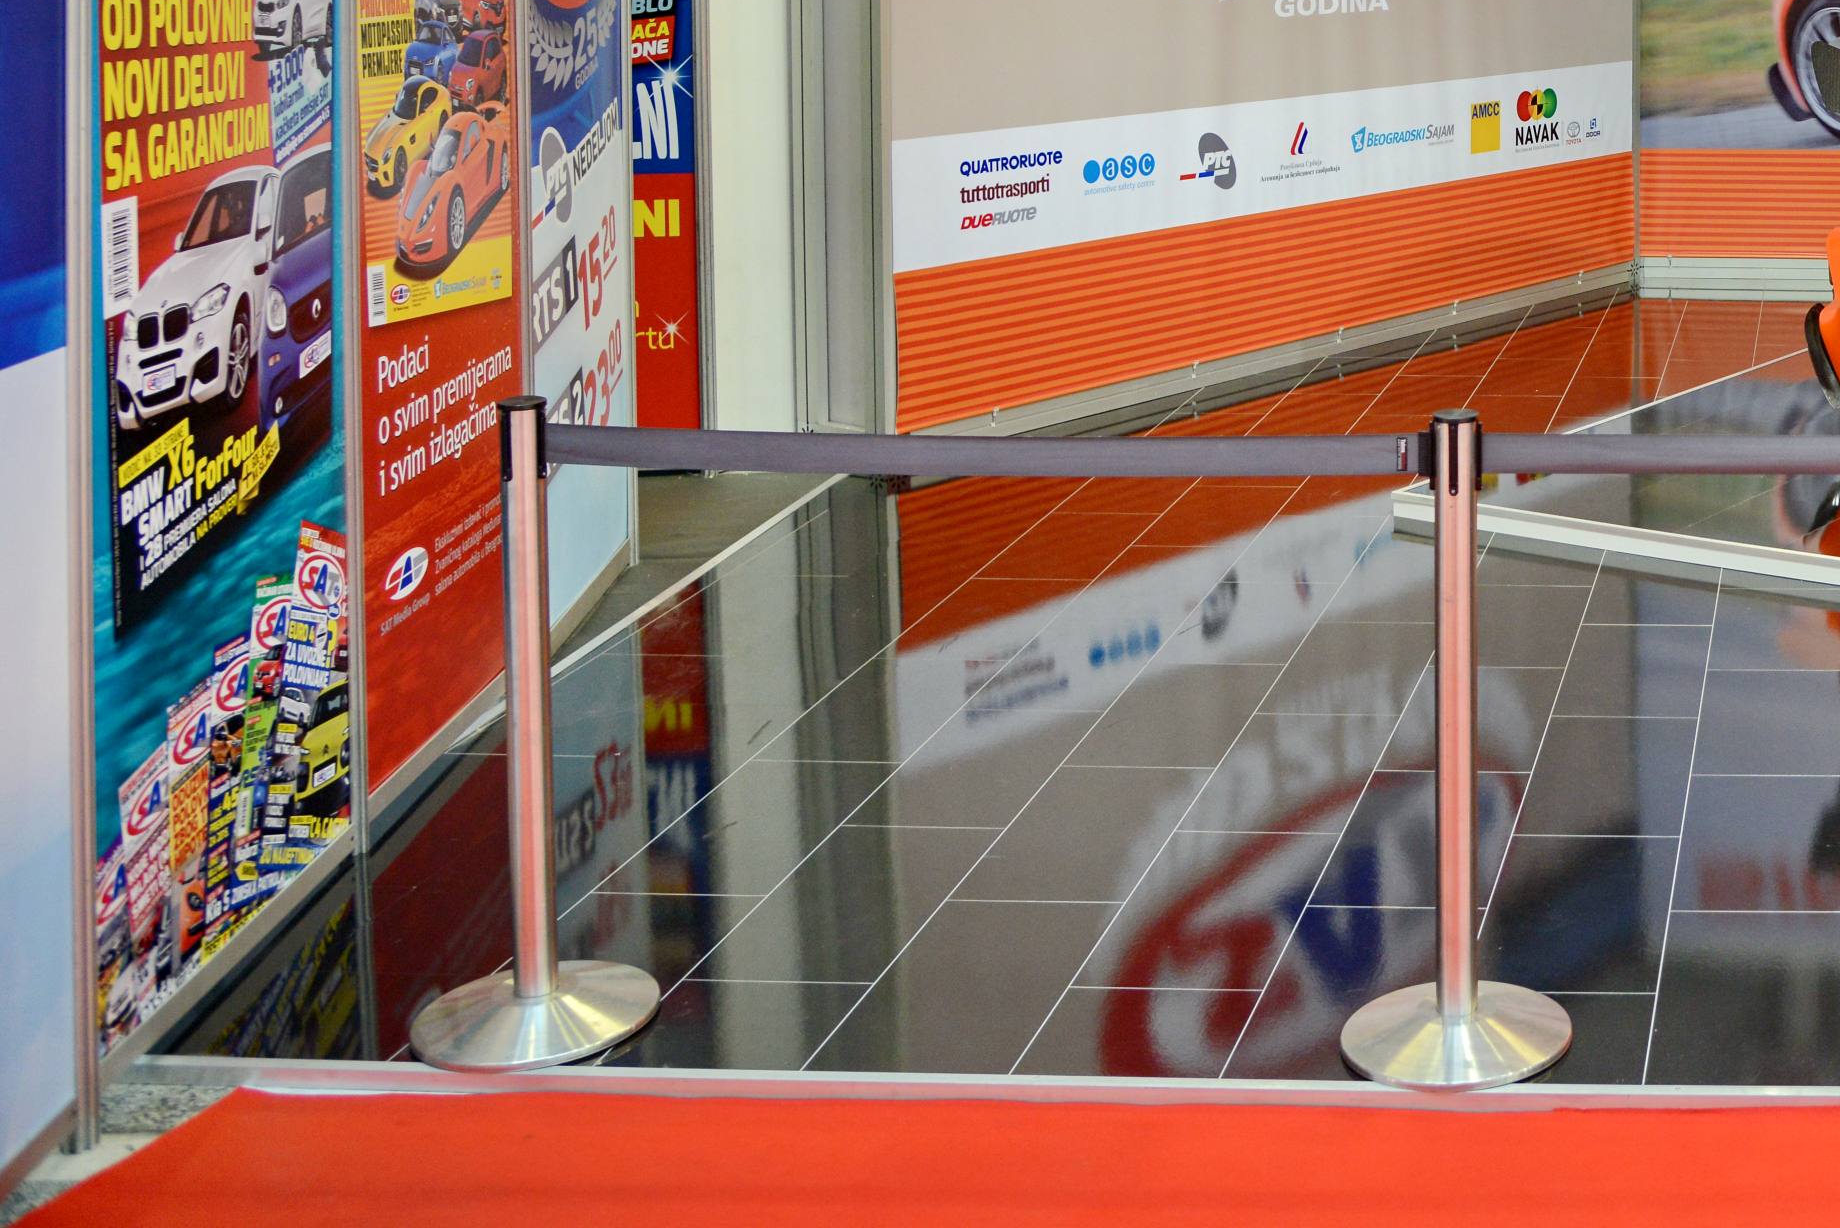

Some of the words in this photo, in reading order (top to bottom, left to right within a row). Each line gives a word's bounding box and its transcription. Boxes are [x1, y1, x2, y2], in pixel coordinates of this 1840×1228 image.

[574, 7, 598, 72] 25
[631, 18, 671, 40] AČA
[103, 57, 169, 122] NOVI
[174, 50, 245, 110] DELOVI
[1471, 101, 1500, 120] AMCC
[105, 128, 143, 192] SA
[148, 103, 269, 180] GARANCIJOM
[572, 97, 619, 187] NEDELJOM
[1515, 121, 1560, 147] NAVAK
[1566, 138, 1582, 146] TOYOTA
[960, 173, 1050, 204] tuttotrasporti
[1104, 155, 1153, 179] asc
[633, 198, 681, 238] NI
[565, 250, 576, 302] 1
[377, 334, 430, 394] Podaci
[378, 415, 391, 445] o
[393, 392, 430, 438] svim
[433, 345, 513, 418] premijerama
[379, 460, 387, 497] i
[390, 445, 427, 491] svim
[430, 399, 498, 467] izlagačima
[121, 466, 165, 526] BMW
[167, 434, 196, 491] X6
[138, 477, 194, 547] SMART
